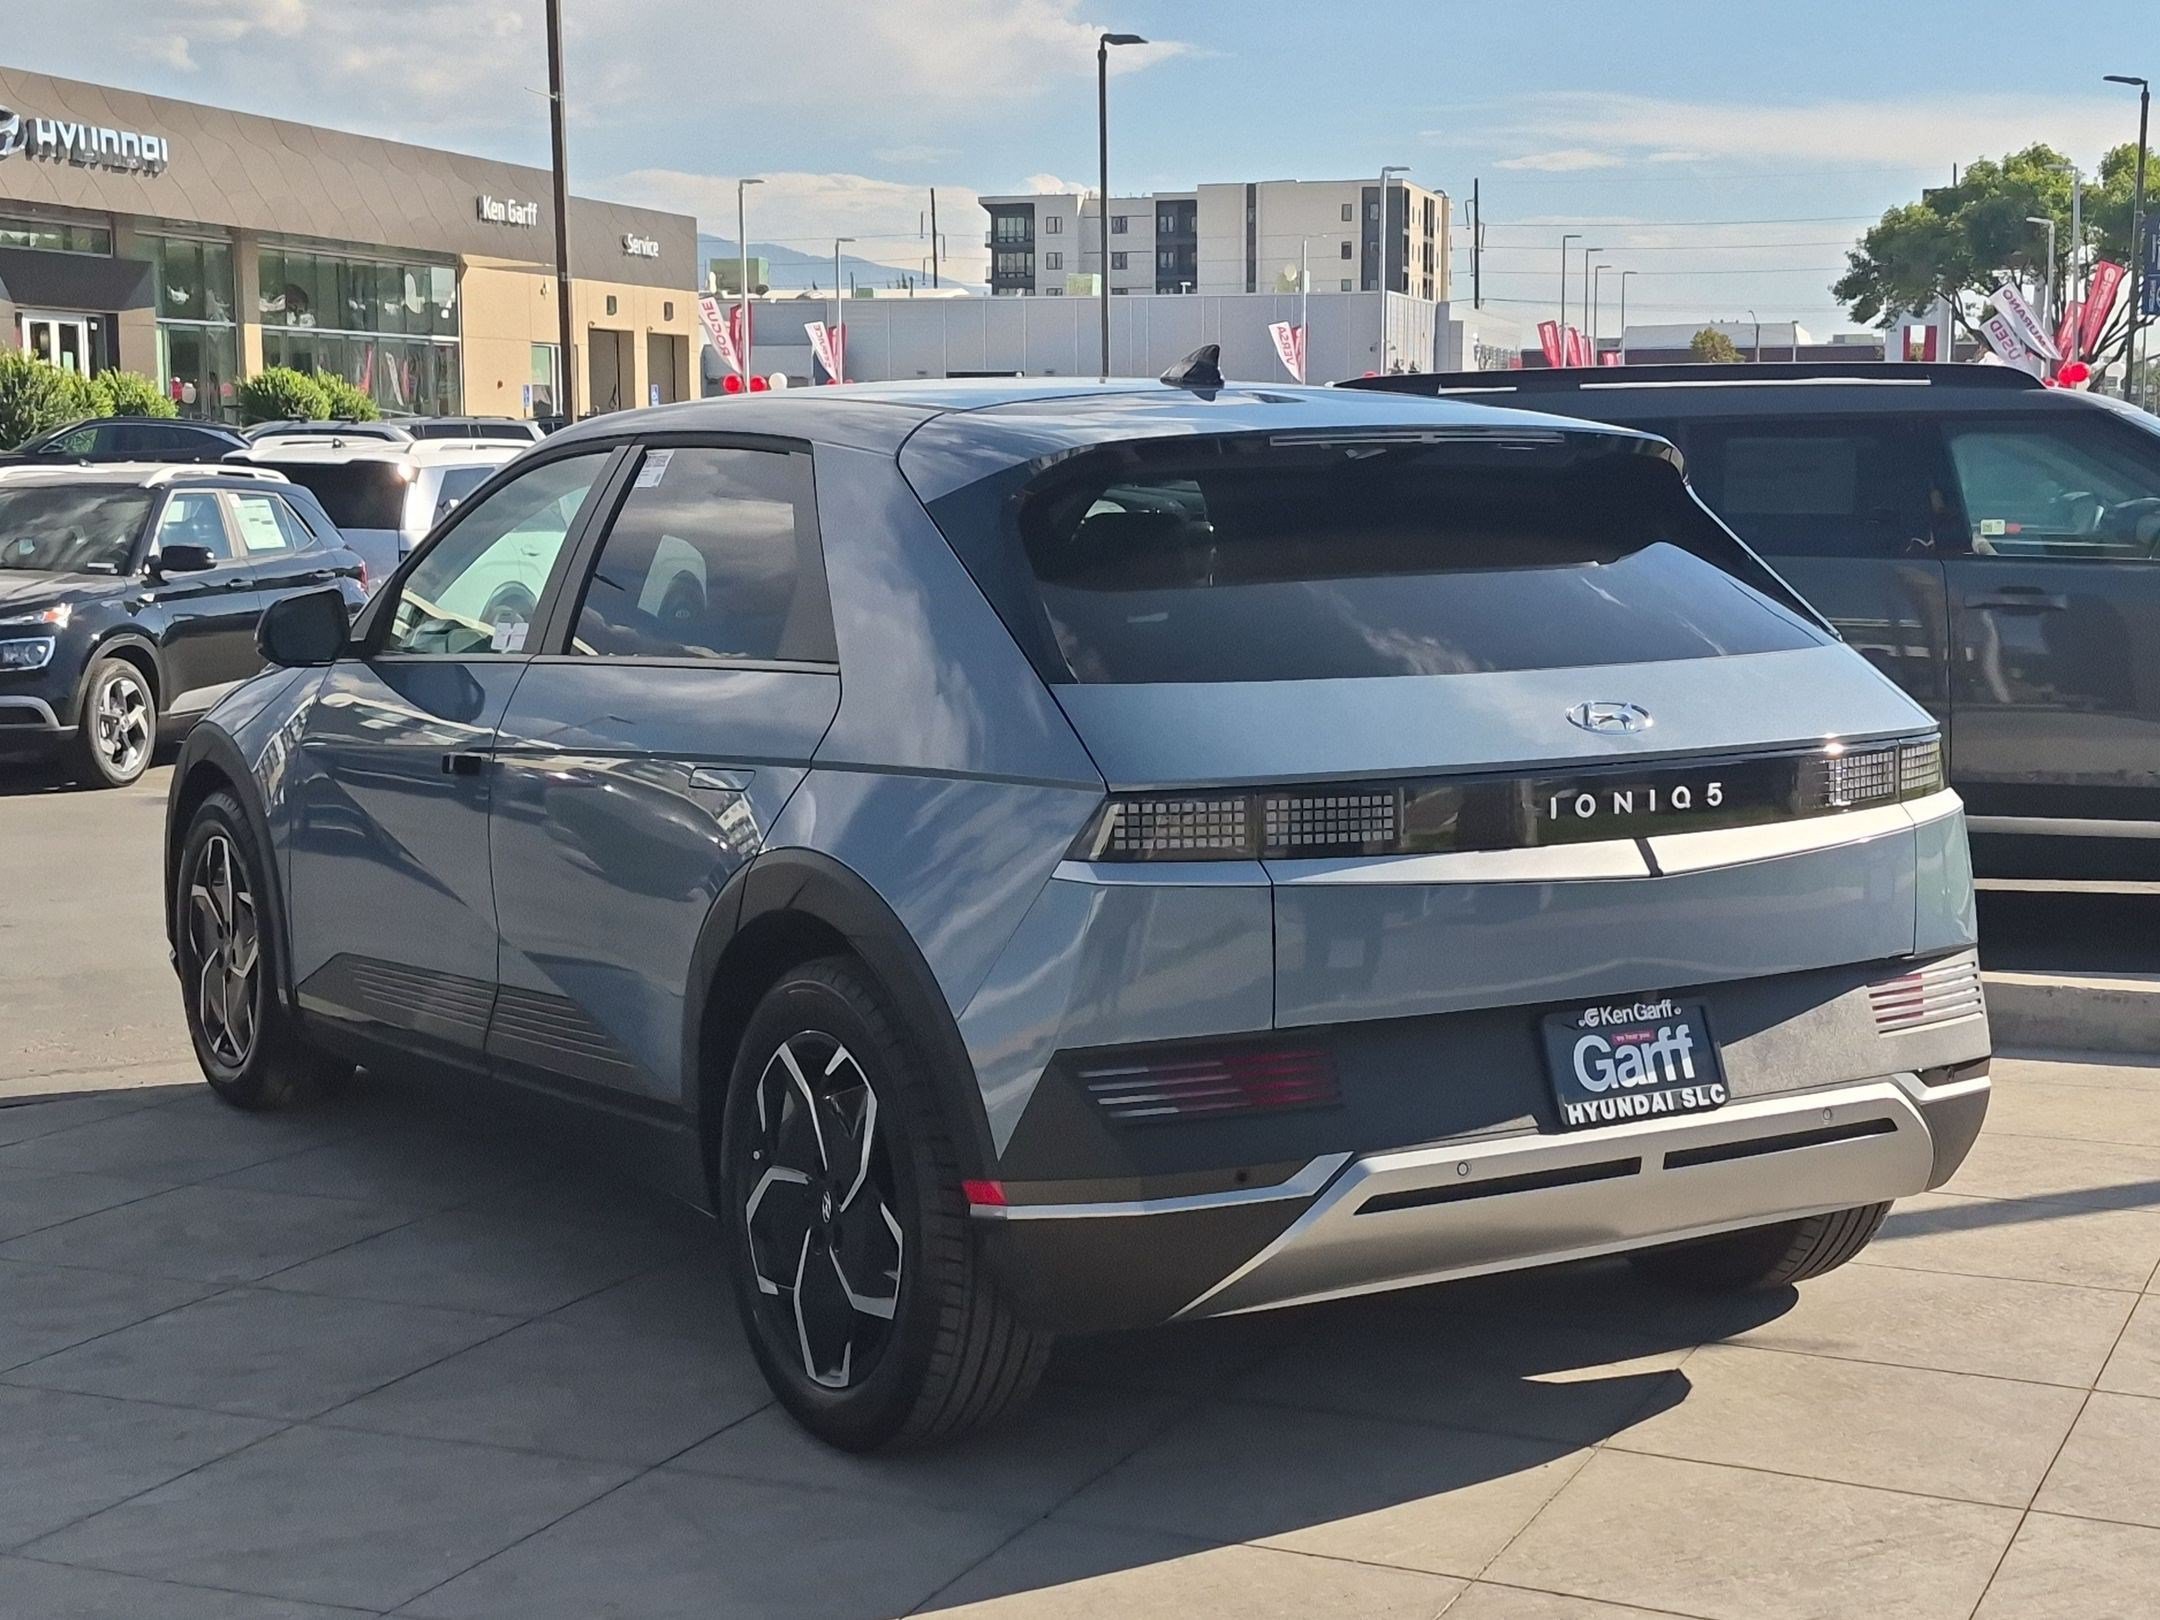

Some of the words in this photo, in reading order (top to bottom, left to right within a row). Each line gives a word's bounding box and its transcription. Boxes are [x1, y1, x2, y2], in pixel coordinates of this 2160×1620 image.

[35, 117, 168, 162] HYUNDAI
[482, 195, 505, 221] Ken
[508, 199, 538, 226] Garff
[627, 233, 659, 257] Service
[1573, 1024, 1696, 1093] Garff
[1567, 1091, 1675, 1126] HYUNDAI
[1682, 1083, 1726, 1109] SLC
